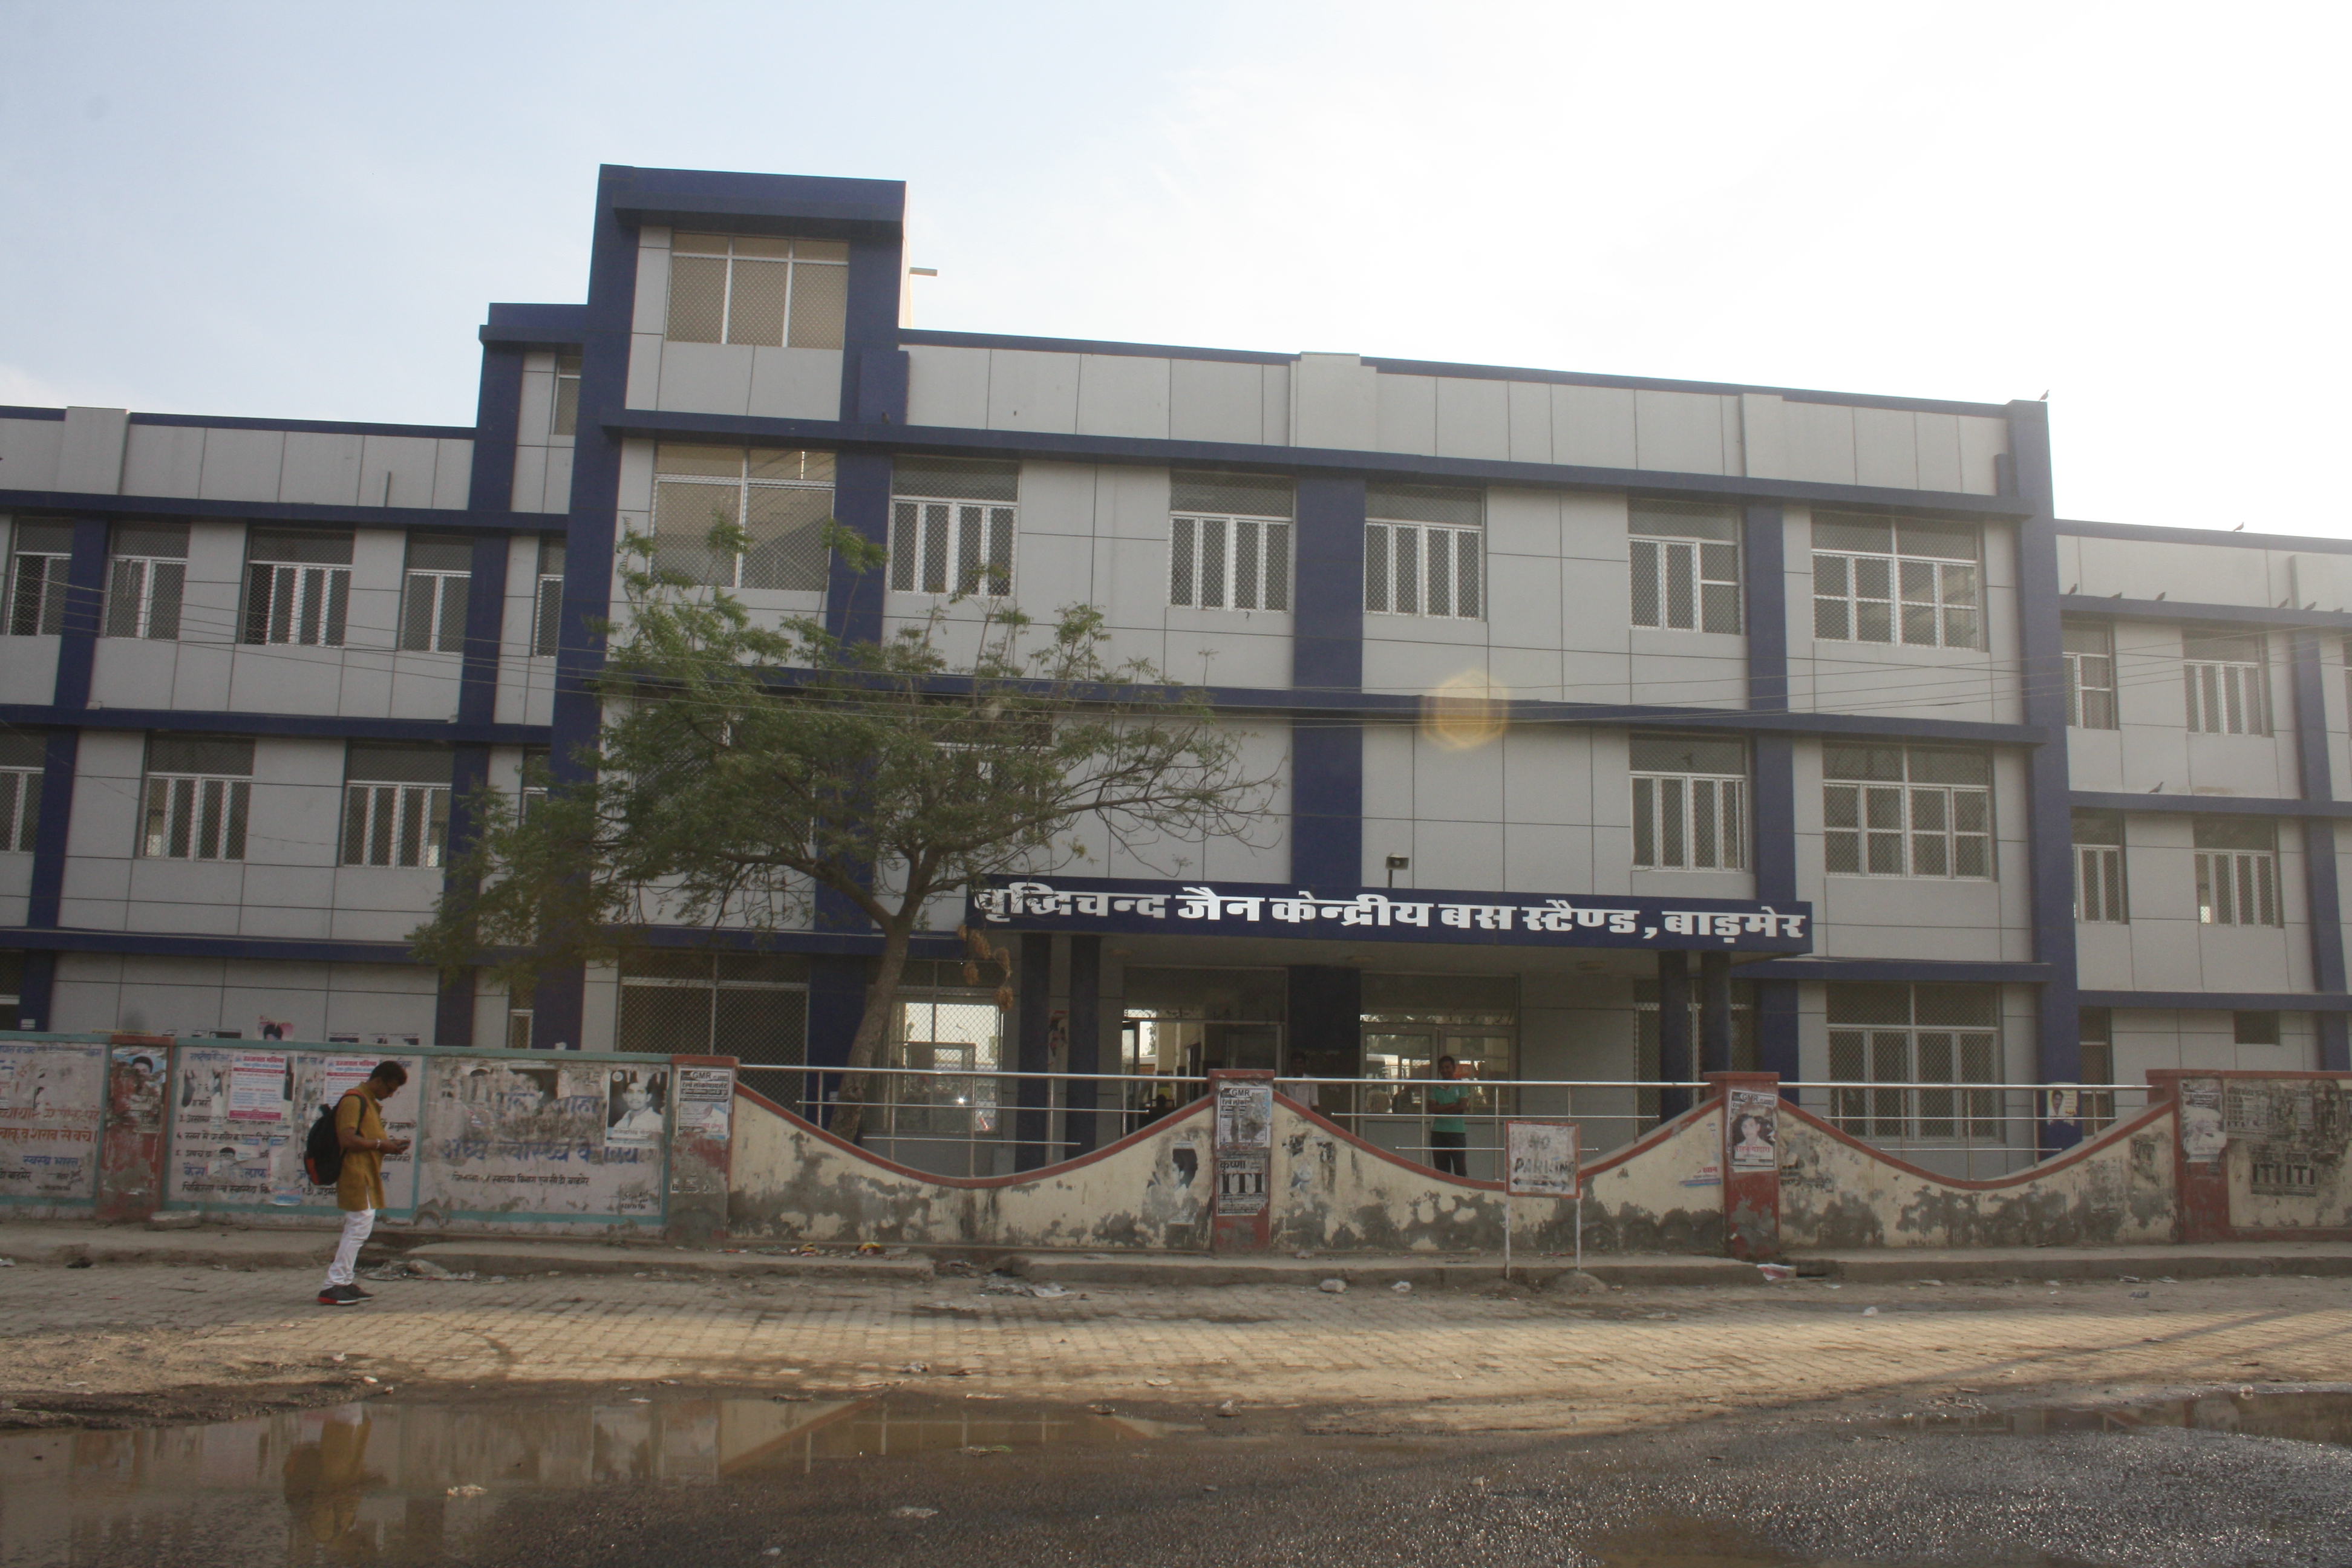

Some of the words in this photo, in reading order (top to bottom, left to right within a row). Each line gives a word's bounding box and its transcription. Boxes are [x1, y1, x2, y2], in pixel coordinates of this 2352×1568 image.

[1175, 886, 1265, 922] जैन
[1269, 890, 1434, 927] केन्द्रीय
[1437, 903, 1517, 930] बस
[1661, 906, 1806, 944] बाड़मेर
[693, 1071, 711, 1079] GMR
[1220, 1172, 1264, 1194] ITI
[2287, 1164, 2315, 1186] ITI
